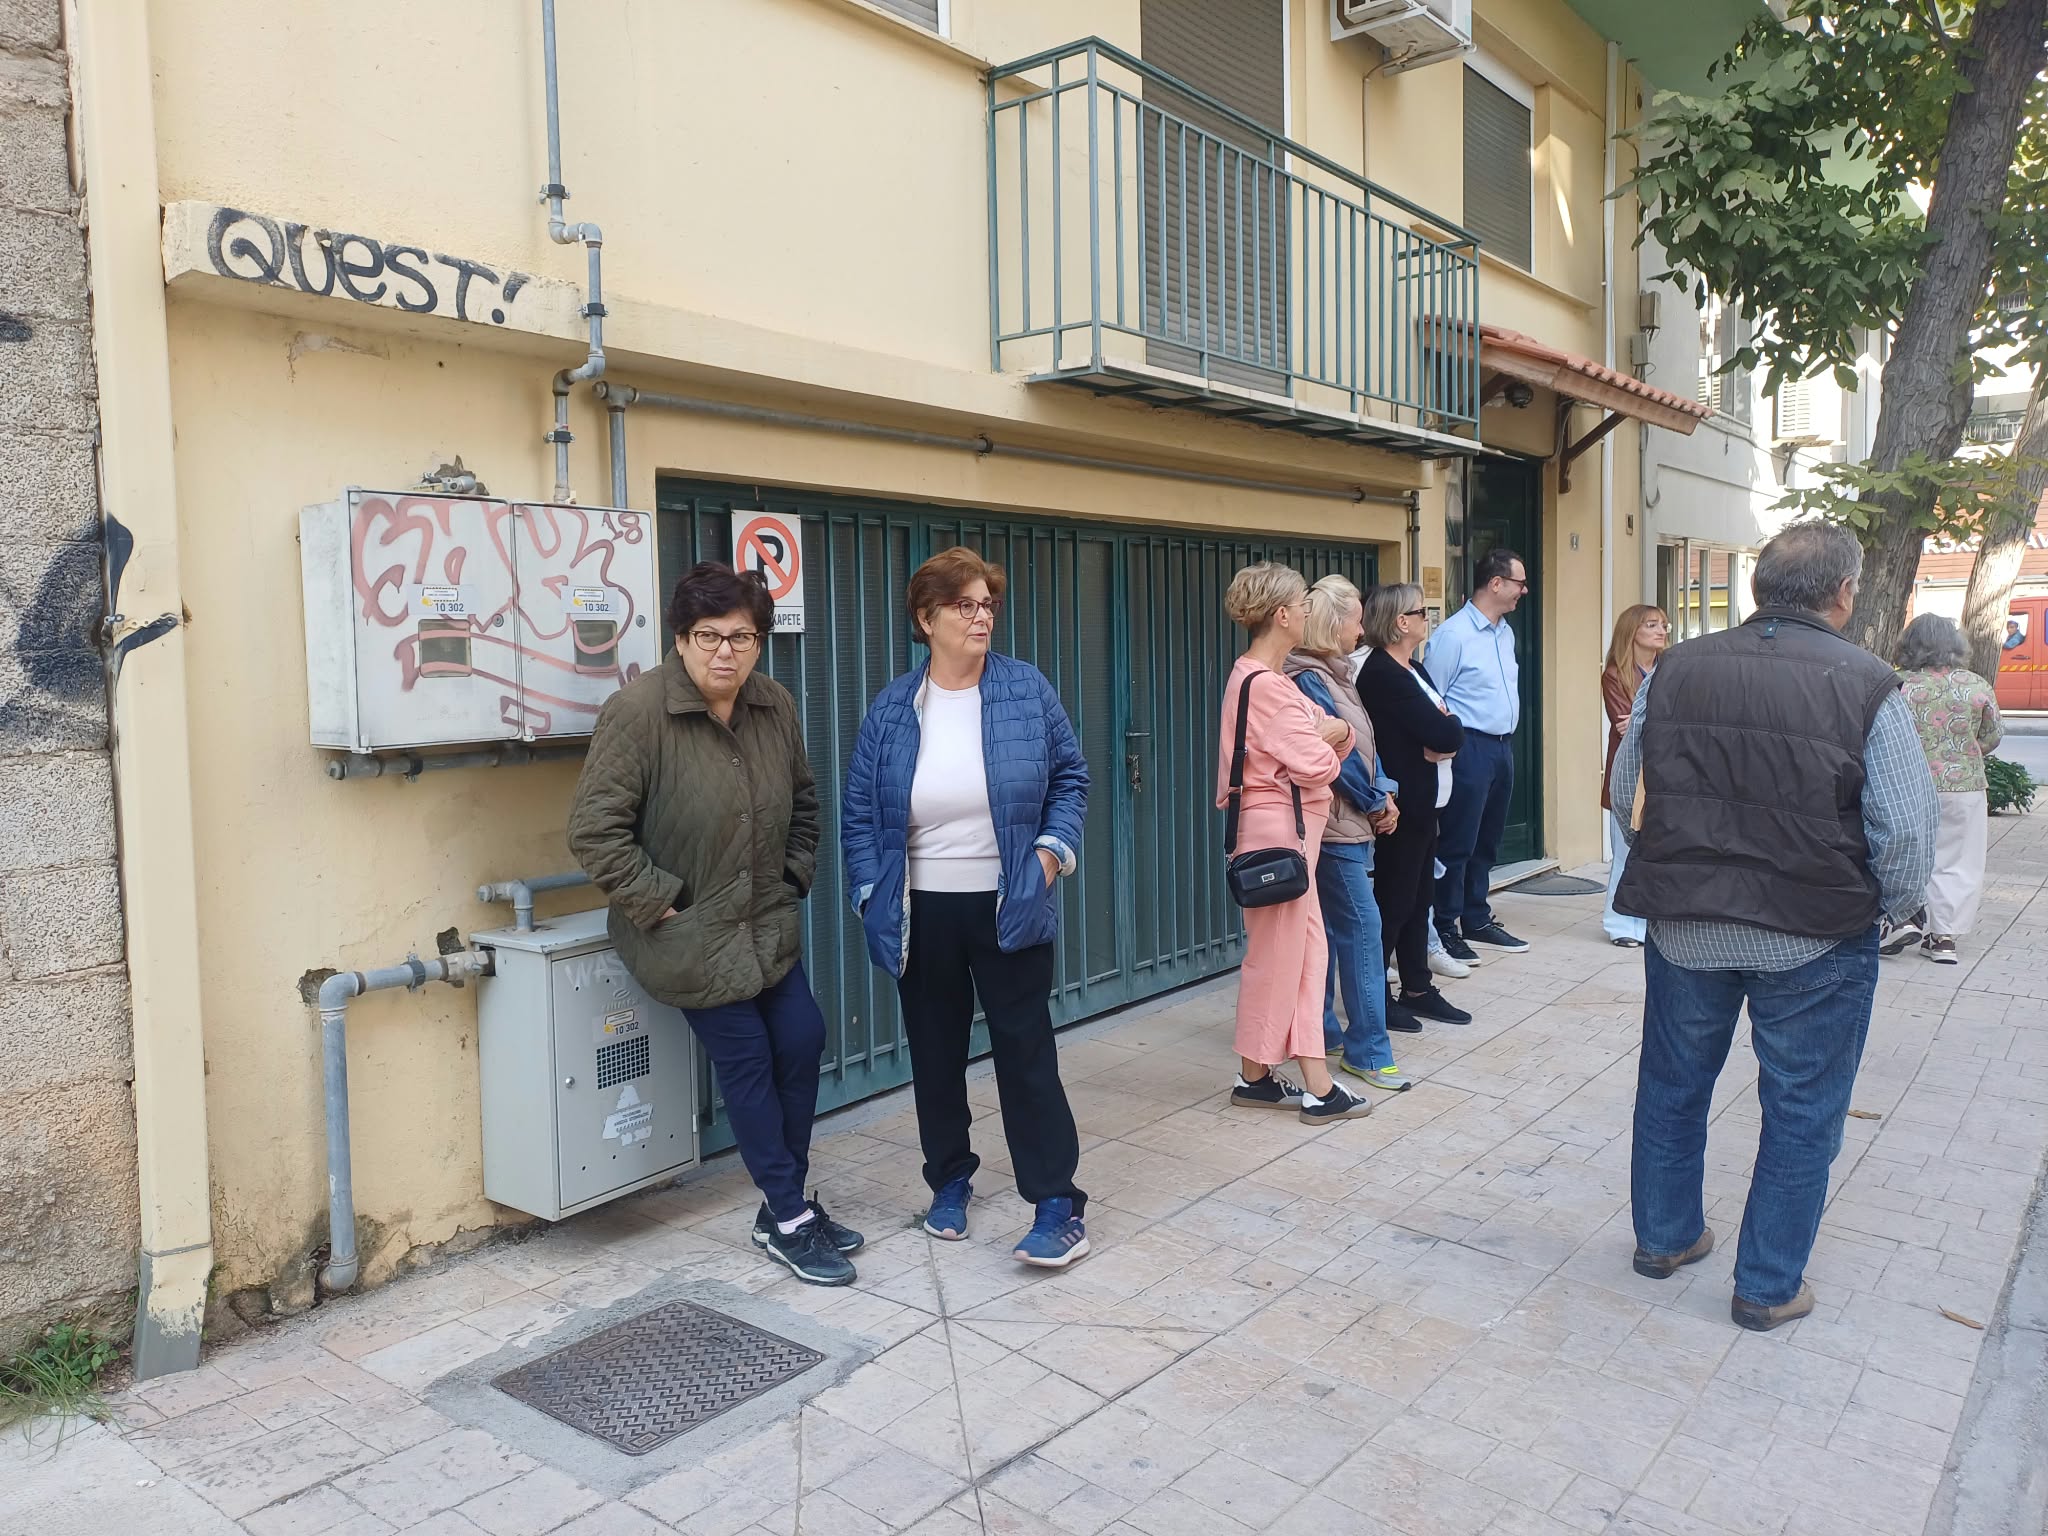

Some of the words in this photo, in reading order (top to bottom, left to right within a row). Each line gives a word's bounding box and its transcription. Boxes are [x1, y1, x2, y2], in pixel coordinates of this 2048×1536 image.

[435, 602, 446, 612] 10
[448, 602, 464, 612] 302
[585, 603, 594, 612] 10
[595, 603, 609, 612] 302
[774, 613, 801, 626] ΚΑΡΕΤΕ
[615, 1026, 624, 1036] 10
[625, 1021, 639, 1032] 302
